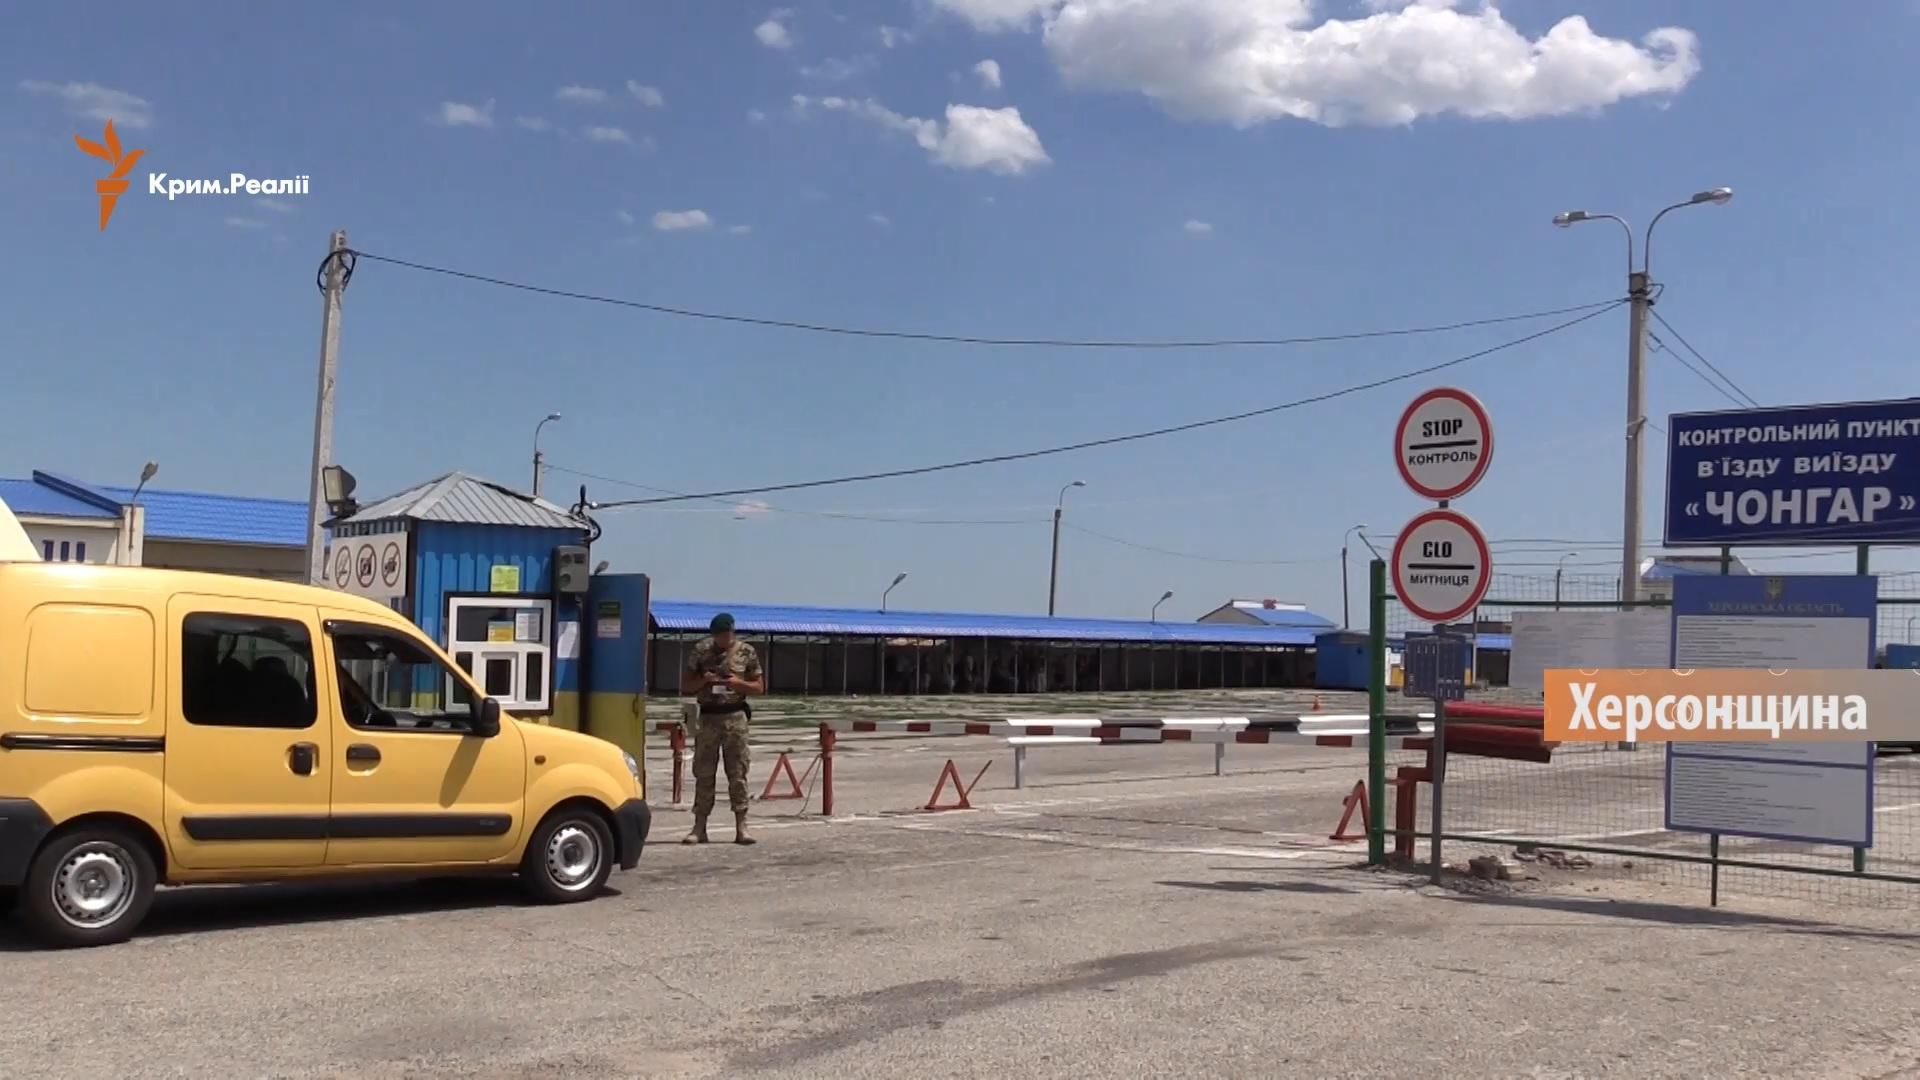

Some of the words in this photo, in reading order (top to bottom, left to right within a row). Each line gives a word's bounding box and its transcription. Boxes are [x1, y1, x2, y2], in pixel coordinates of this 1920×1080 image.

[1422, 419, 1463, 438] STOP
[1679, 420, 1840, 446] КОНТРОЛЬНИЙ
[1847, 419, 1920, 438] ПУНКТ
[1408, 451, 1478, 466] КОНТРОЛЬ
[1794, 452, 1896, 475] ВИЇЗДУ
[1422, 541, 1452, 558] CLO
[1409, 573, 1469, 586] МИТНИЦЯ
